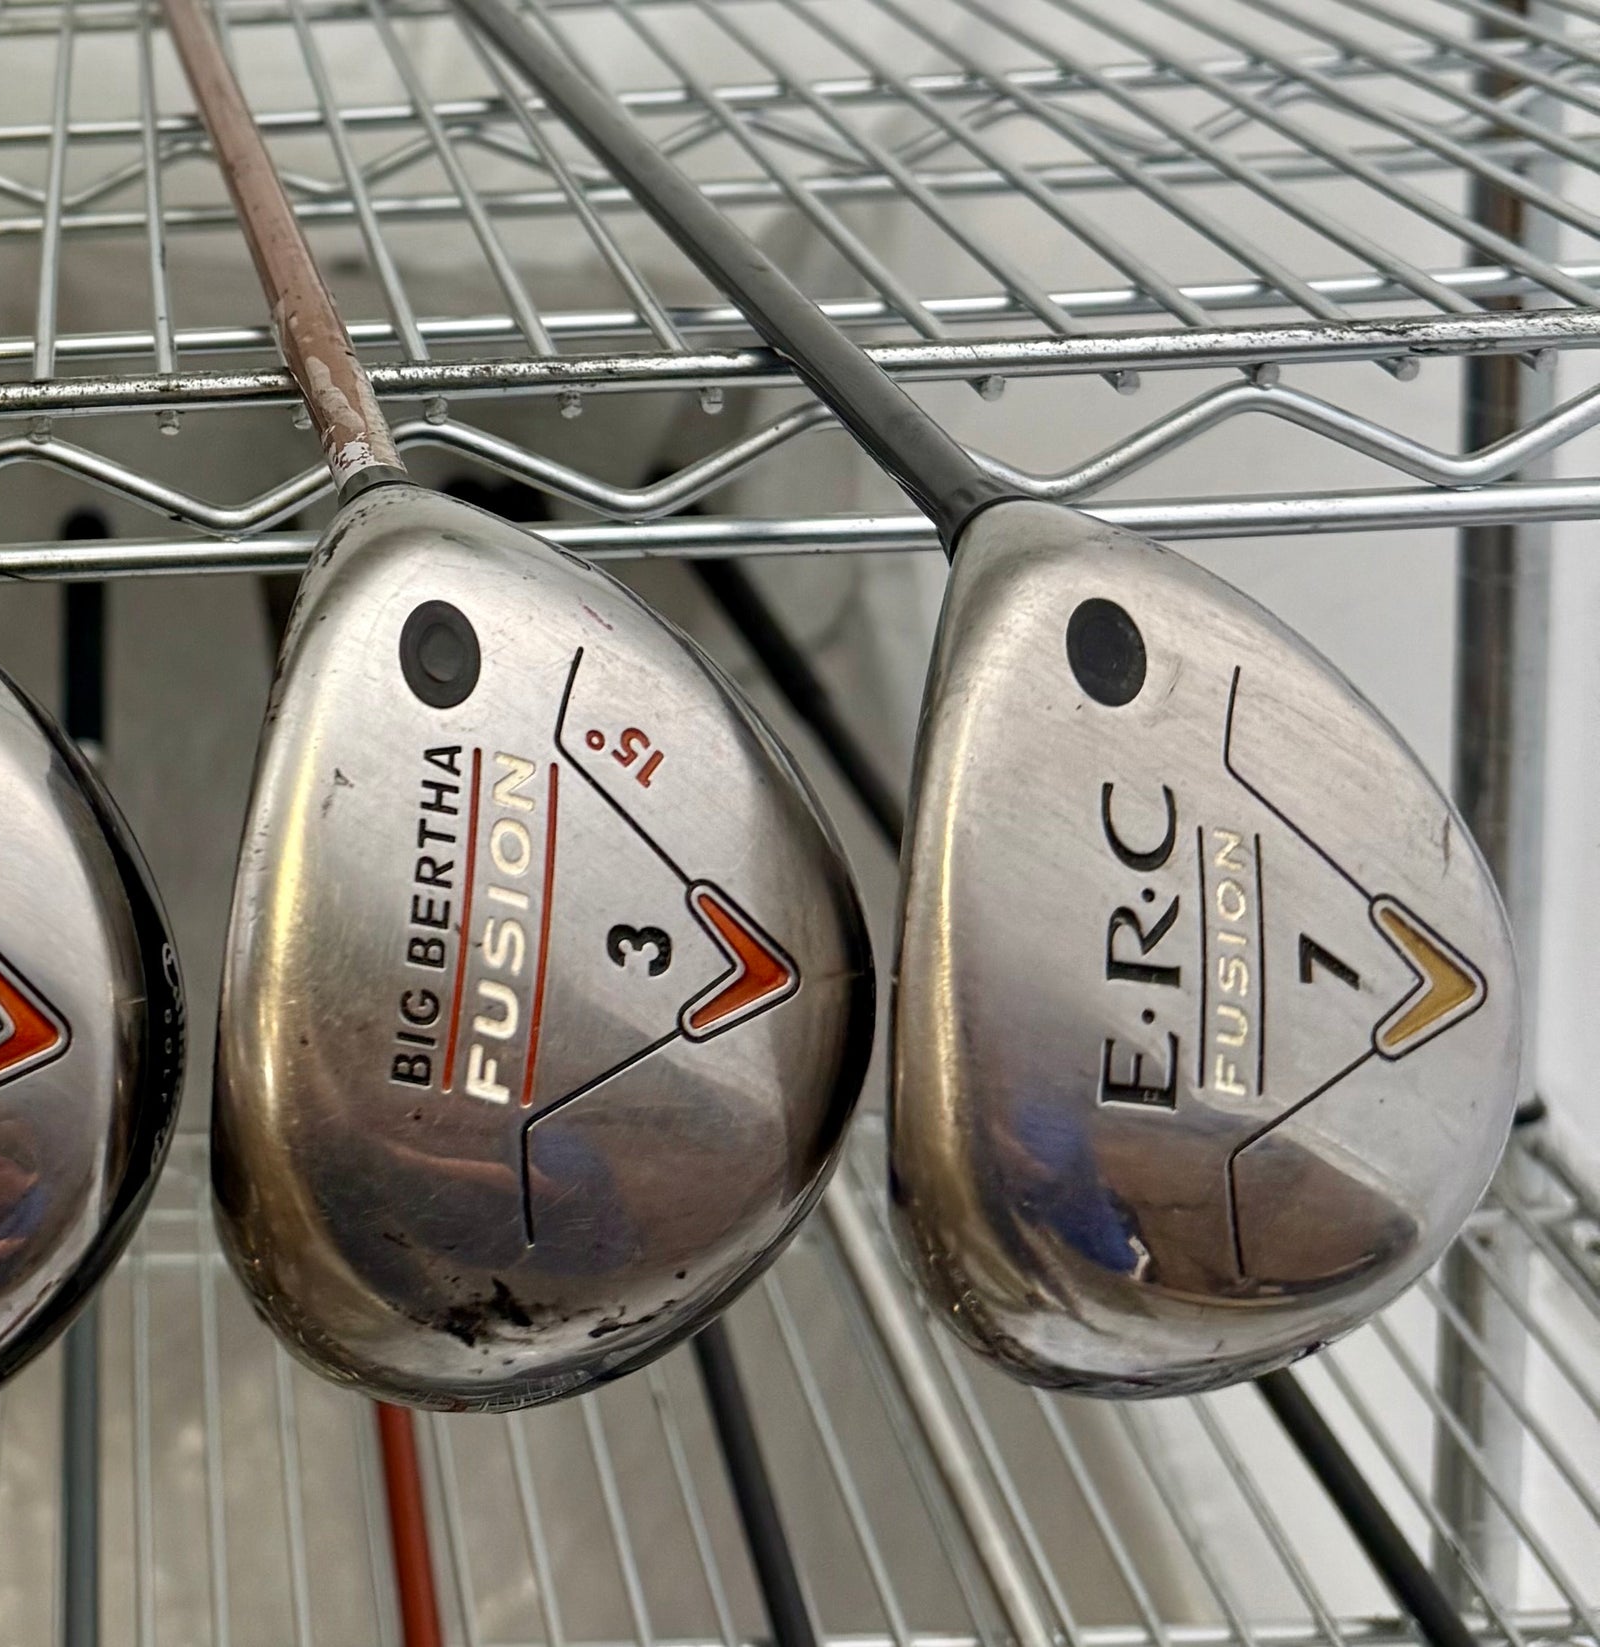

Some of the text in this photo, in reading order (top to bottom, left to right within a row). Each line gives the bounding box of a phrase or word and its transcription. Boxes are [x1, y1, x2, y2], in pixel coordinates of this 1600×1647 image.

[585, 728, 665, 788] 15°
[390, 745, 463, 1089] BIG BERTHA
[465, 751, 537, 1104] FUSION
[607, 923, 672, 978] 3
[1213, 827, 1249, 1096] FUSION
[1299, 932, 1361, 991] 7
